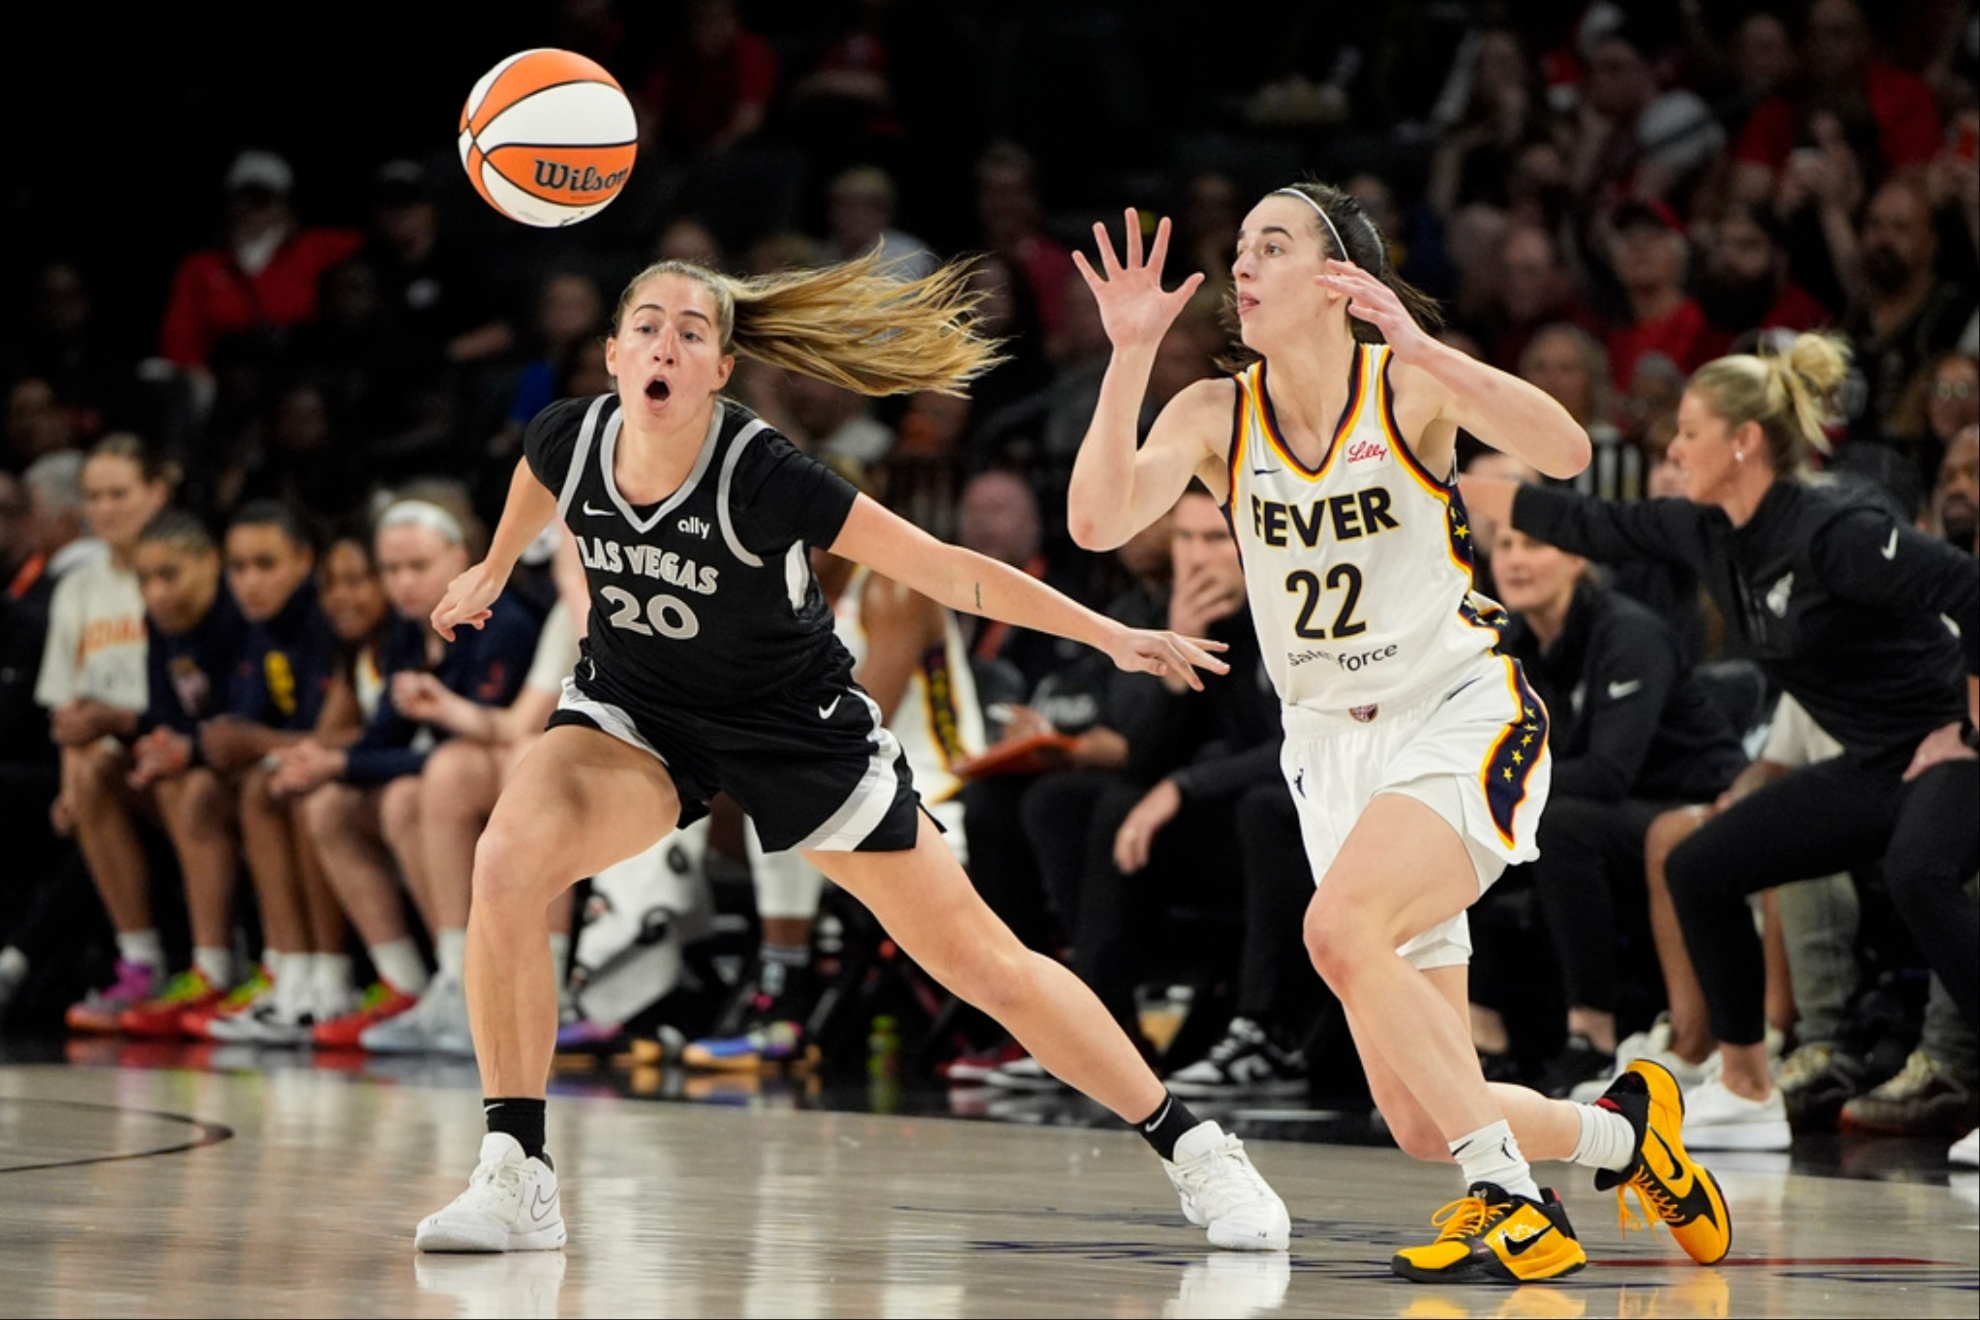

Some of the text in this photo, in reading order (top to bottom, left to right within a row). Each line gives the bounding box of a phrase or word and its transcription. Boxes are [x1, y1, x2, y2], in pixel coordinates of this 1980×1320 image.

[534, 158, 628, 192] Wilson
[1347, 440, 1387, 463] Lilly
[677, 516, 711, 539] ally
[1250, 486, 1401, 548] FEVER
[575, 536, 720, 595] LAS VEGAS
[600, 585, 700, 640] 20
[1284, 562, 1367, 640] 22
[1287, 644, 1398, 672] saleforce
